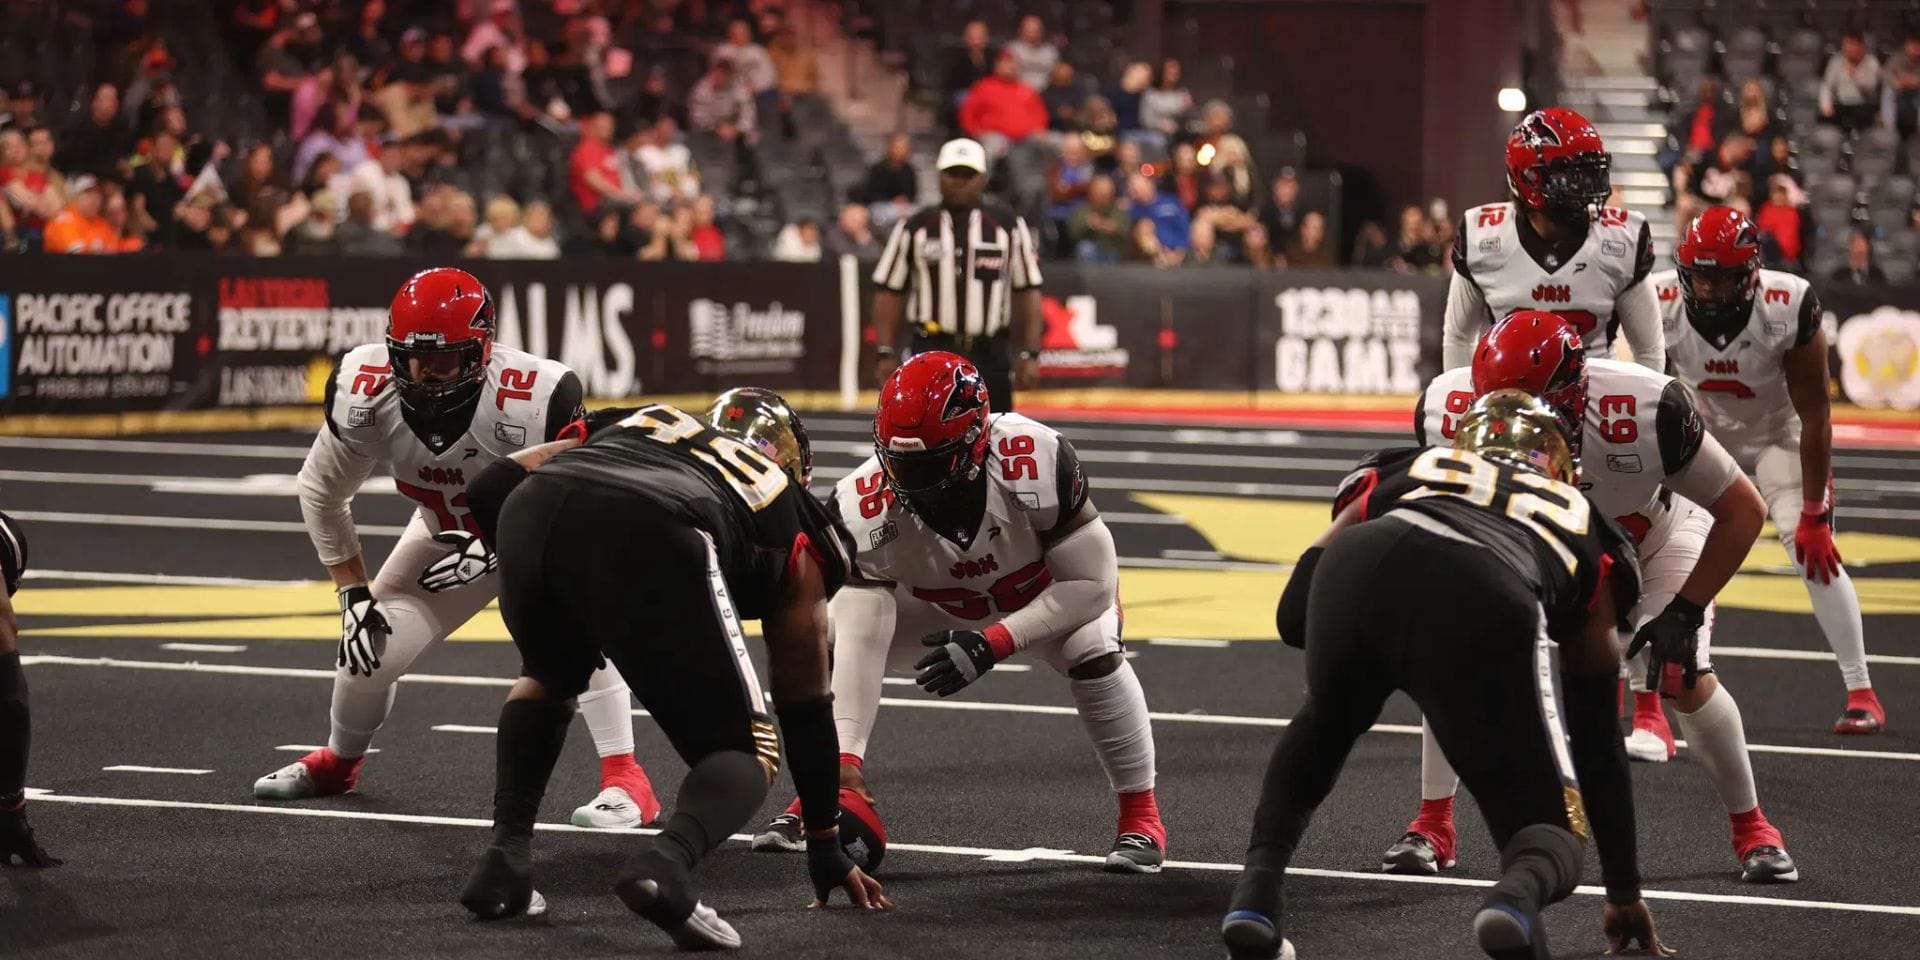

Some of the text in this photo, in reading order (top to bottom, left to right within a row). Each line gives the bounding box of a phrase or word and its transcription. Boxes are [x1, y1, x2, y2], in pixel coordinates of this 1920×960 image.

[16, 291, 192, 334] PACIFIC OFFICE
[17, 333, 175, 376] AUTOMATION
[496, 282, 635, 397] ALMS
[496, 367, 538, 412] 72
[1599, 393, 1638, 444] 63
[998, 434, 1039, 481] 56
[1400, 445, 1591, 578] 92
